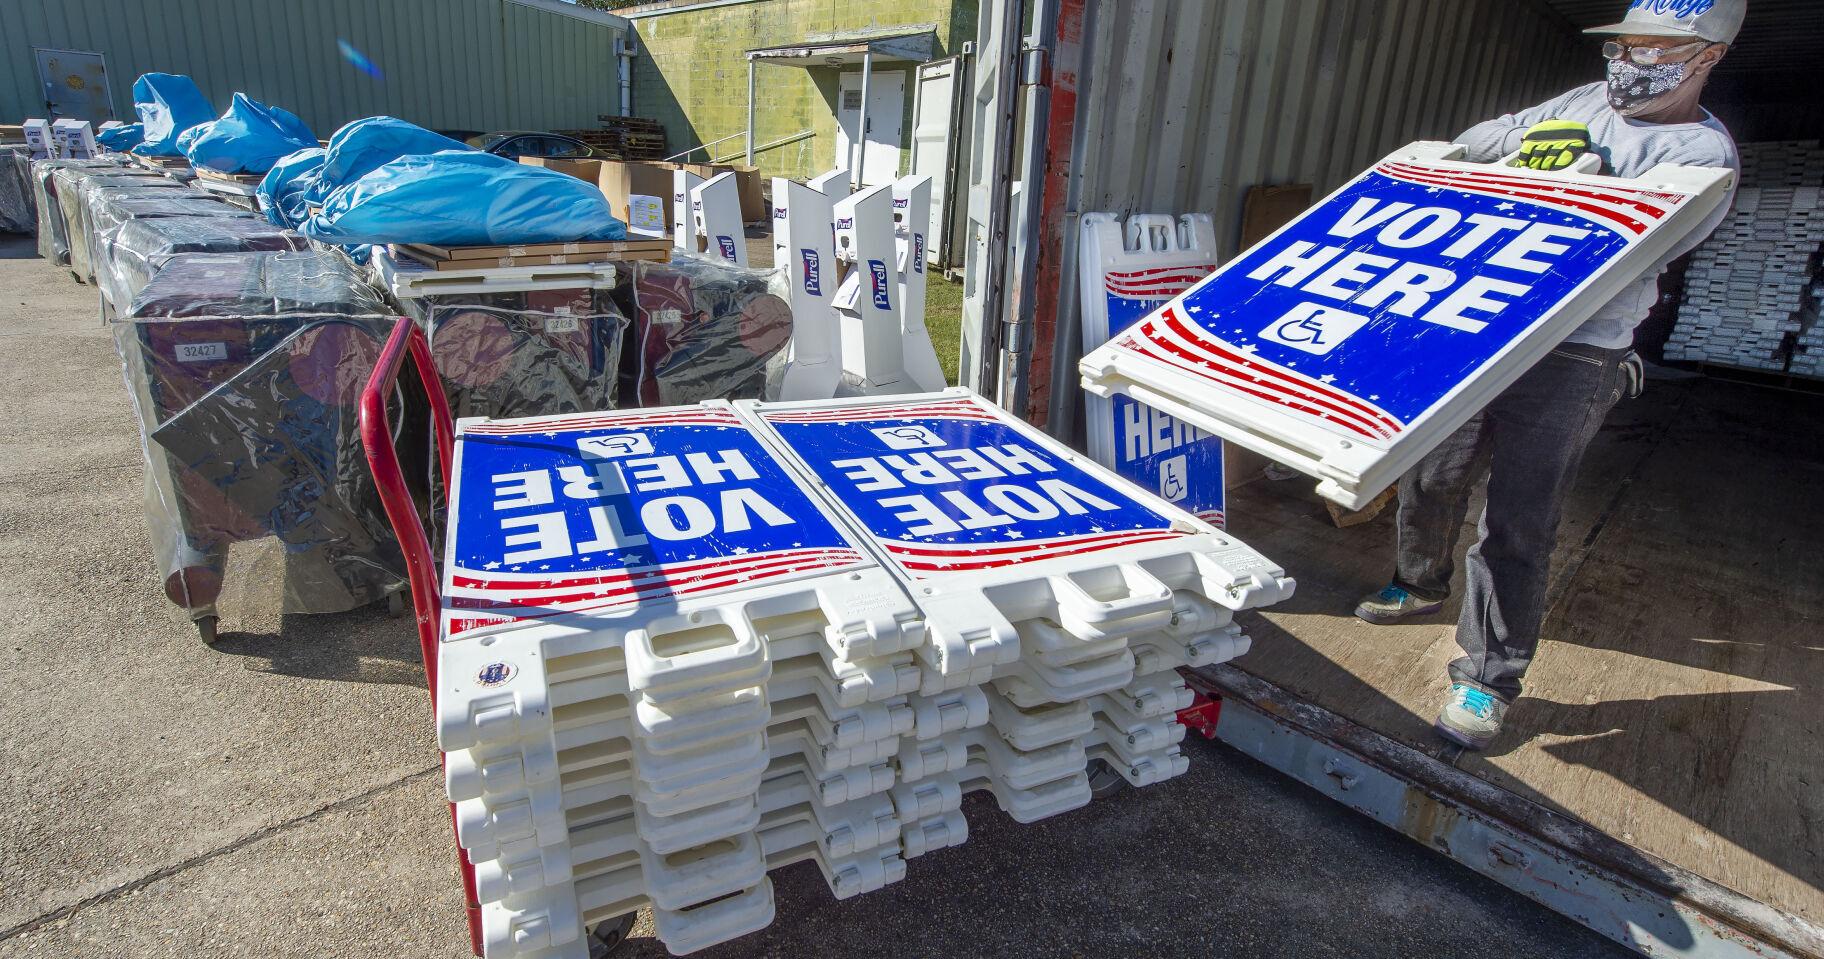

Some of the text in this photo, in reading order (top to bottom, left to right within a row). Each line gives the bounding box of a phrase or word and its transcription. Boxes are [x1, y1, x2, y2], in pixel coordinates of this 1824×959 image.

[914, 236, 923, 270] Purell
[1327, 197, 1593, 274] VOTE
[806, 252, 819, 291] Purell
[873, 263, 888, 305] Purell
[1246, 240, 1533, 333] HERE
[184, 345, 216, 357] 32427
[1124, 400, 1215, 462] HE
[491, 449, 760, 511] HERE
[831, 444, 1058, 492] HERE
[501, 487, 796, 565] VOTE
[876, 479, 1122, 537] VOTE
